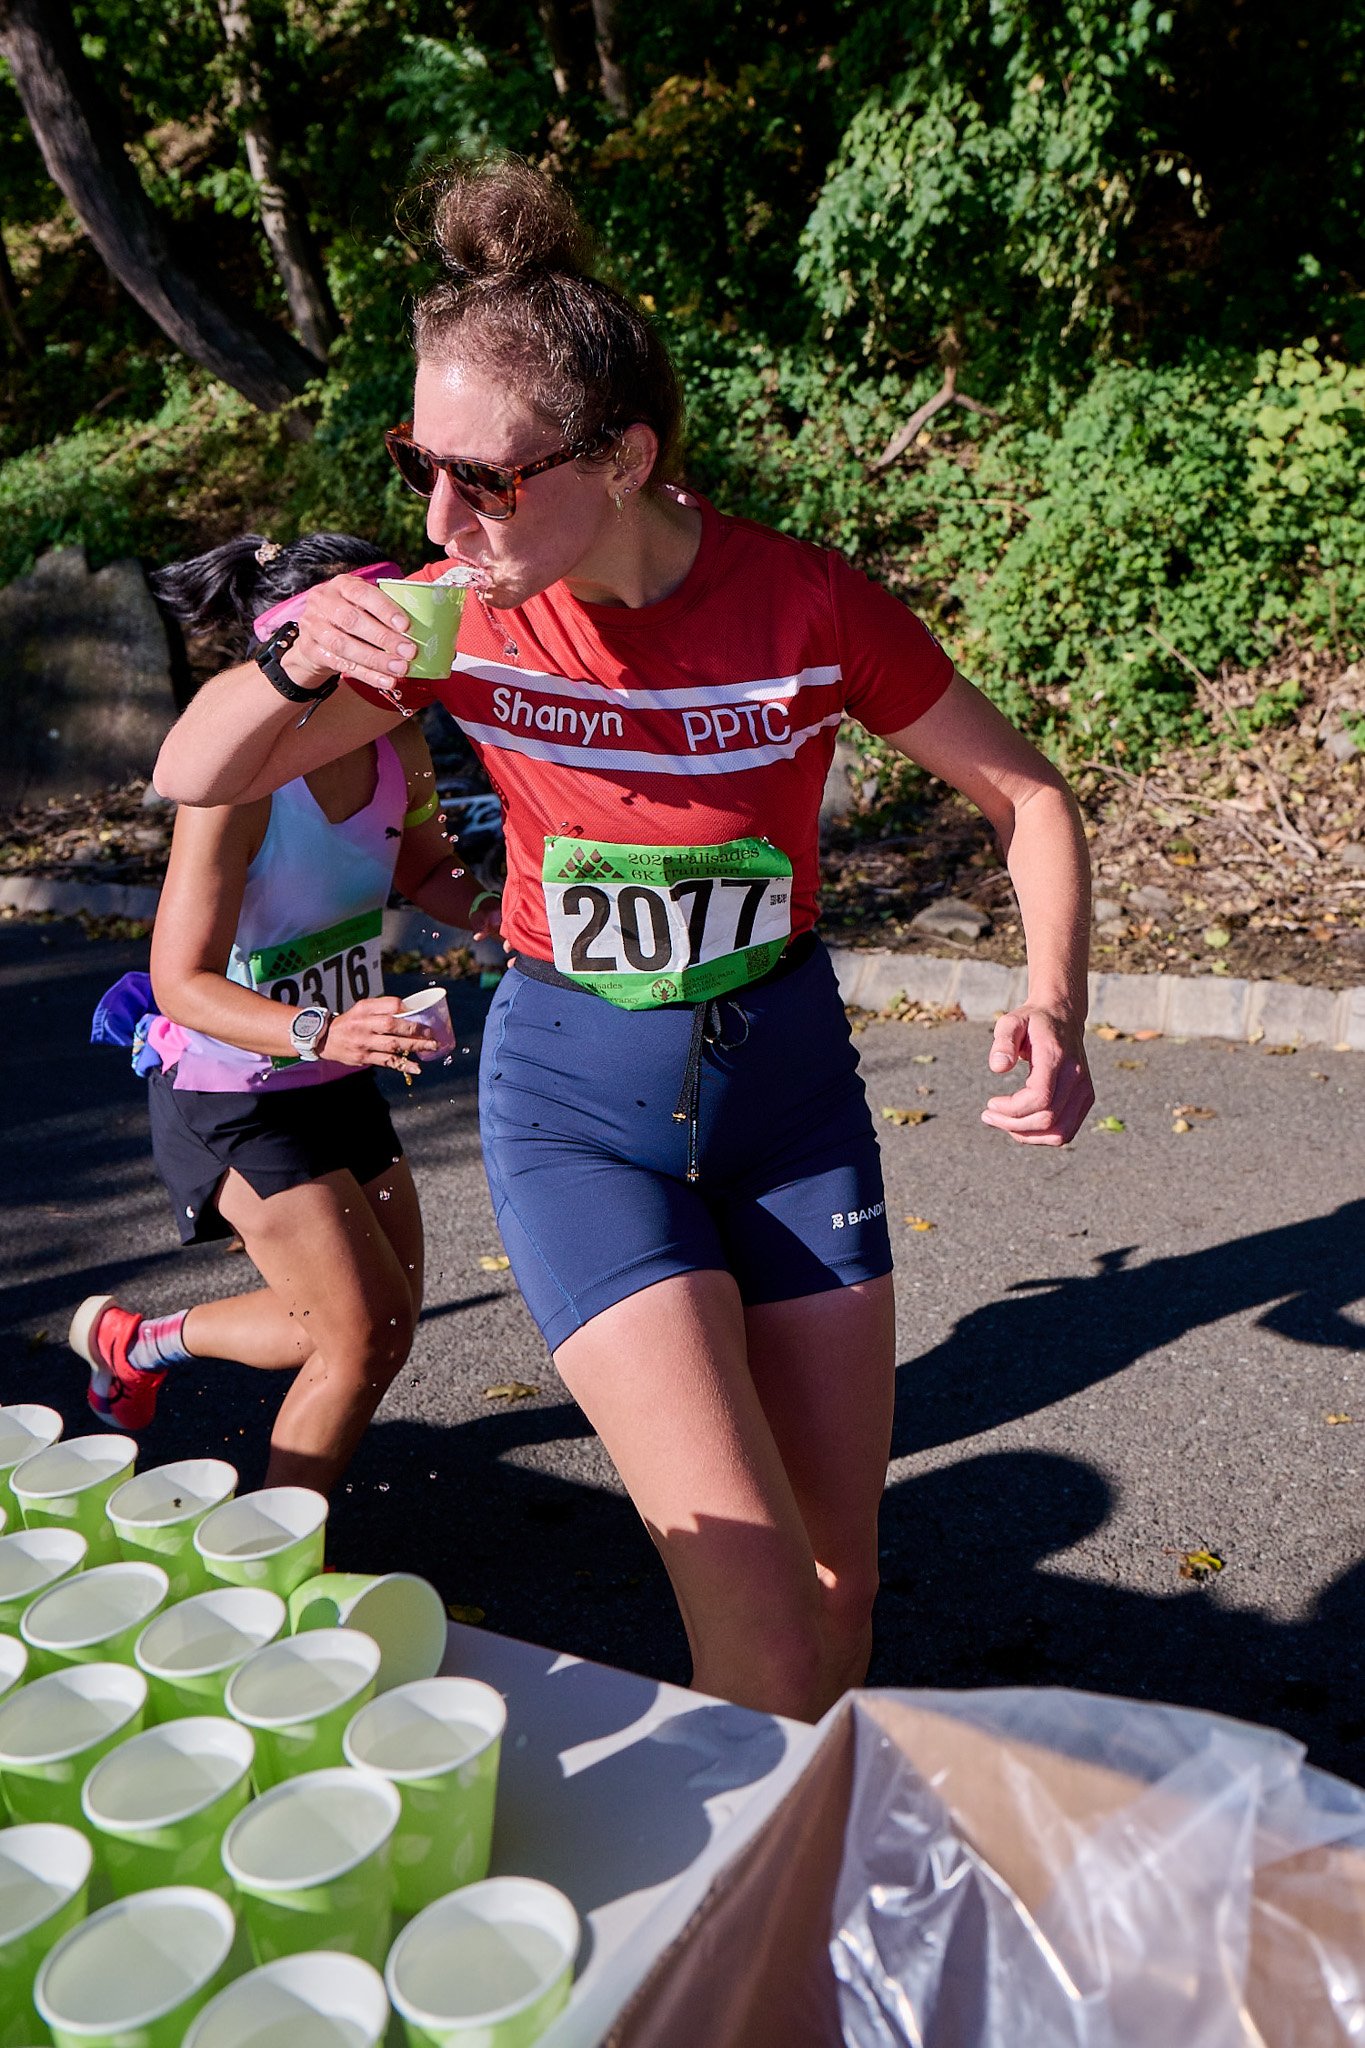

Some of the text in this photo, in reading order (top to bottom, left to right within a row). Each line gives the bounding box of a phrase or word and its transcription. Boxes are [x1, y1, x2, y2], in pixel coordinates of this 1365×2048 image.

[493, 687, 791, 752] Shanyn PPTC
[631, 867, 741, 882] 6K Trail Run
[677, 848, 760, 864] Palisades
[562, 878, 770, 972] 2077
